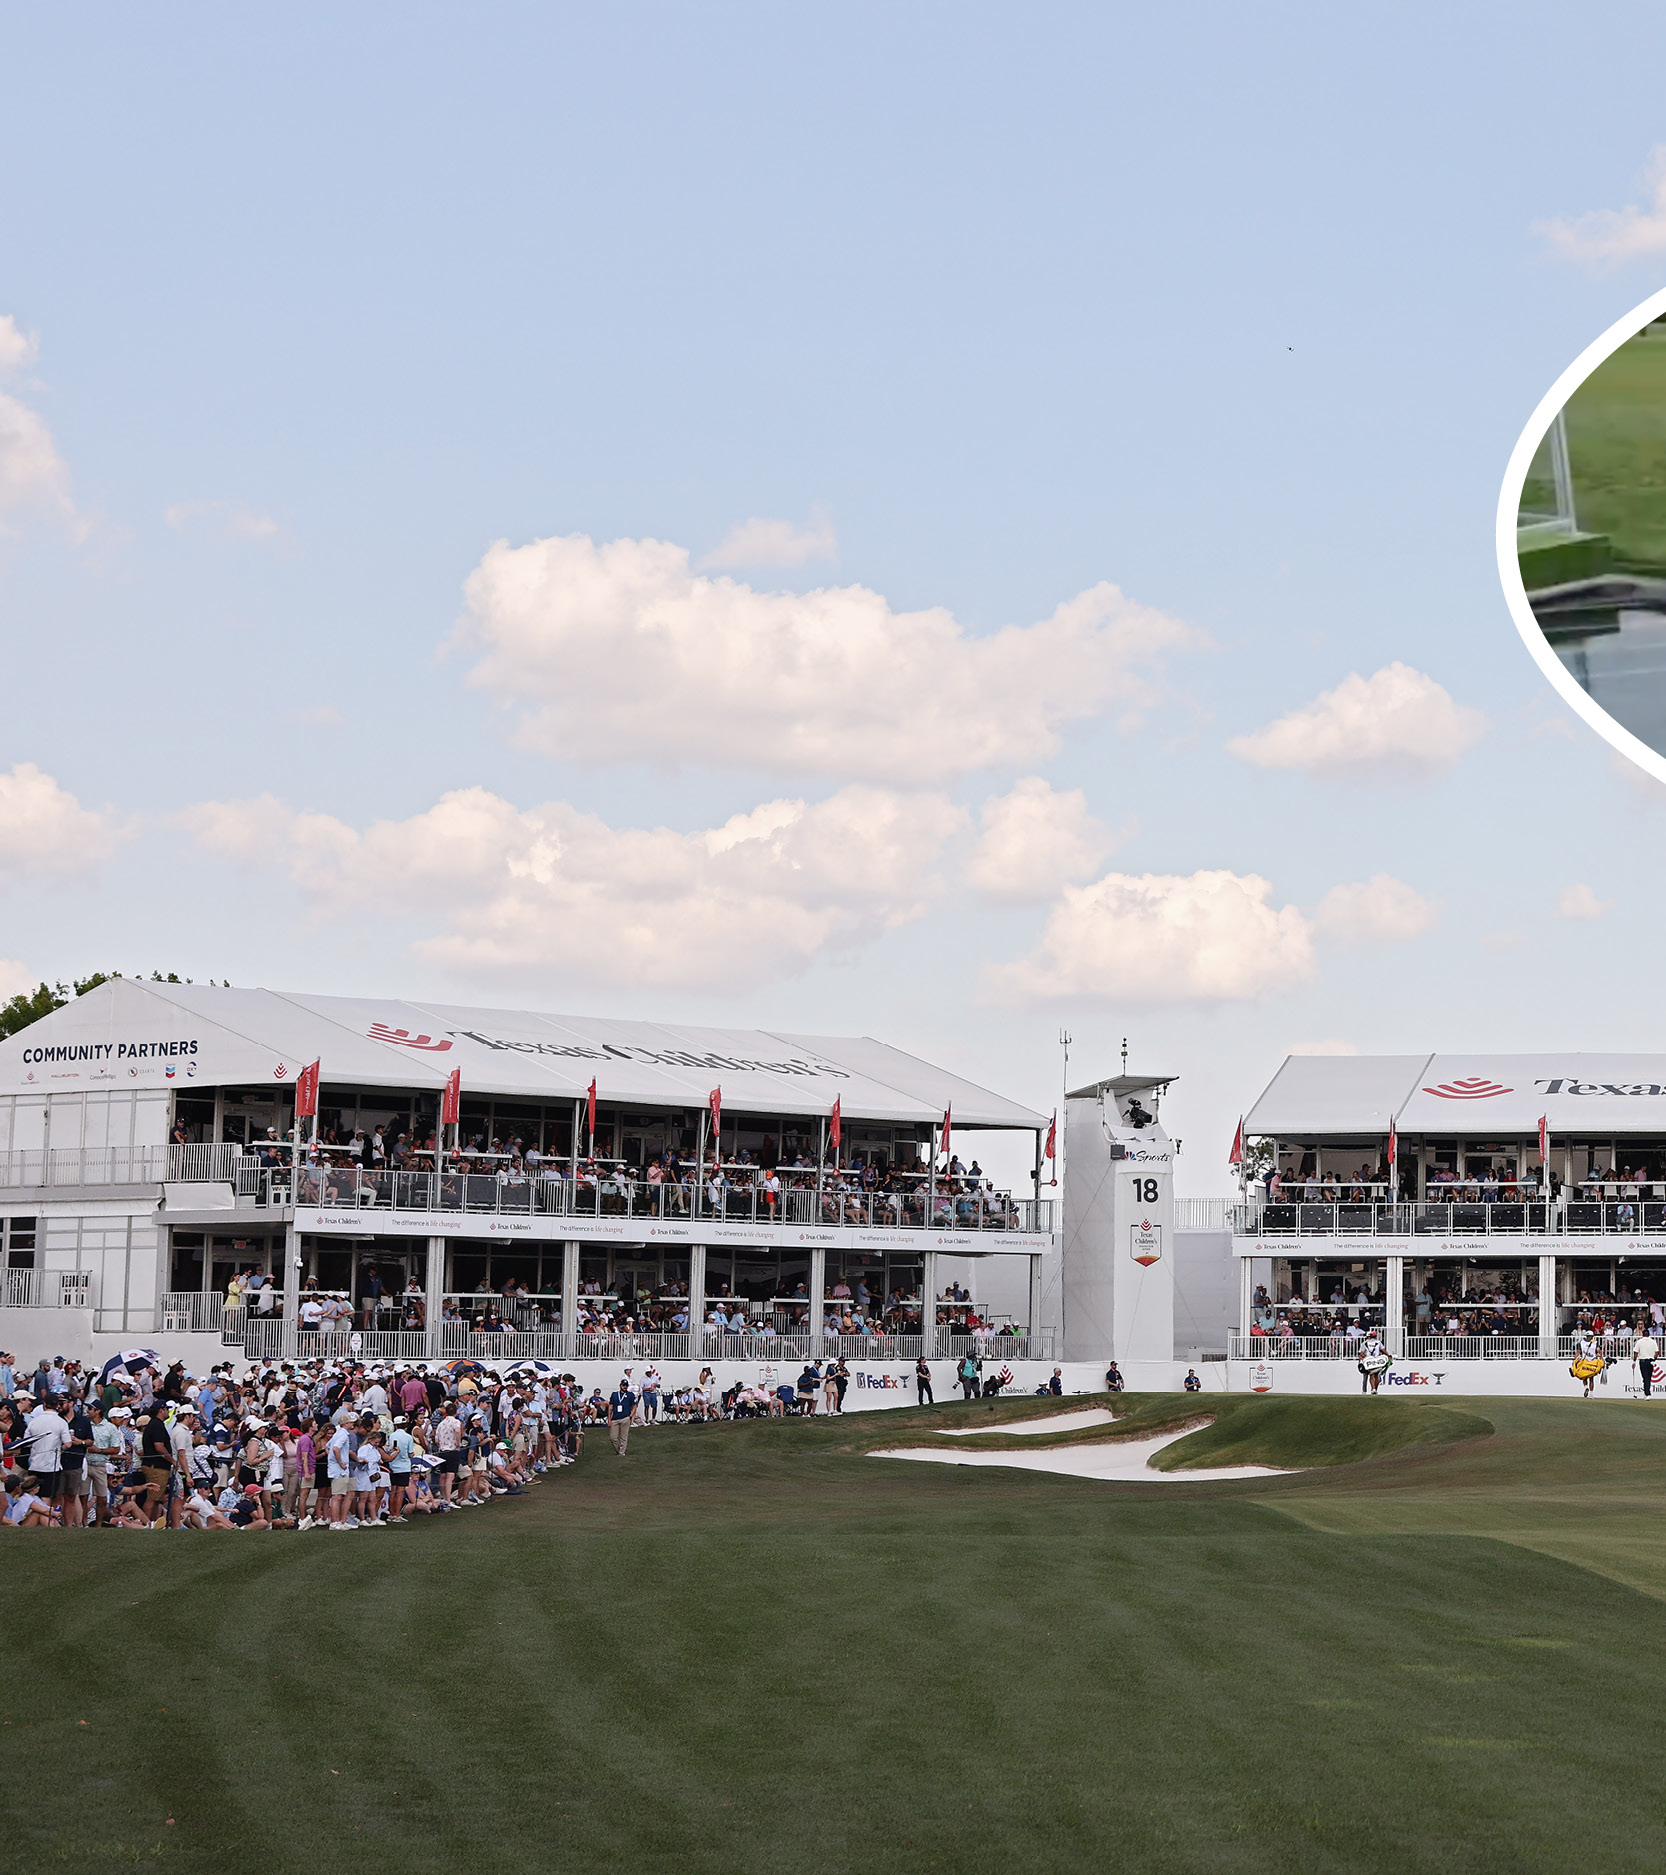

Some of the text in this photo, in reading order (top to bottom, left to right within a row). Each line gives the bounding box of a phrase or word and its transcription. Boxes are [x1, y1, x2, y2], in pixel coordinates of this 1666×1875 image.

[23, 1040, 198, 1064] COMMUNITY PARTNERS
[445, 1031, 850, 1078] Texas Children's
[1136, 1150, 1170, 1163] Sports
[1132, 1178, 1158, 1203] 18
[439, 1220, 461, 1228] changing
[1366, 1359, 1385, 1367] PING
[867, 1375, 898, 1389] FedEx
[1388, 1372, 1428, 1385] FedEx
